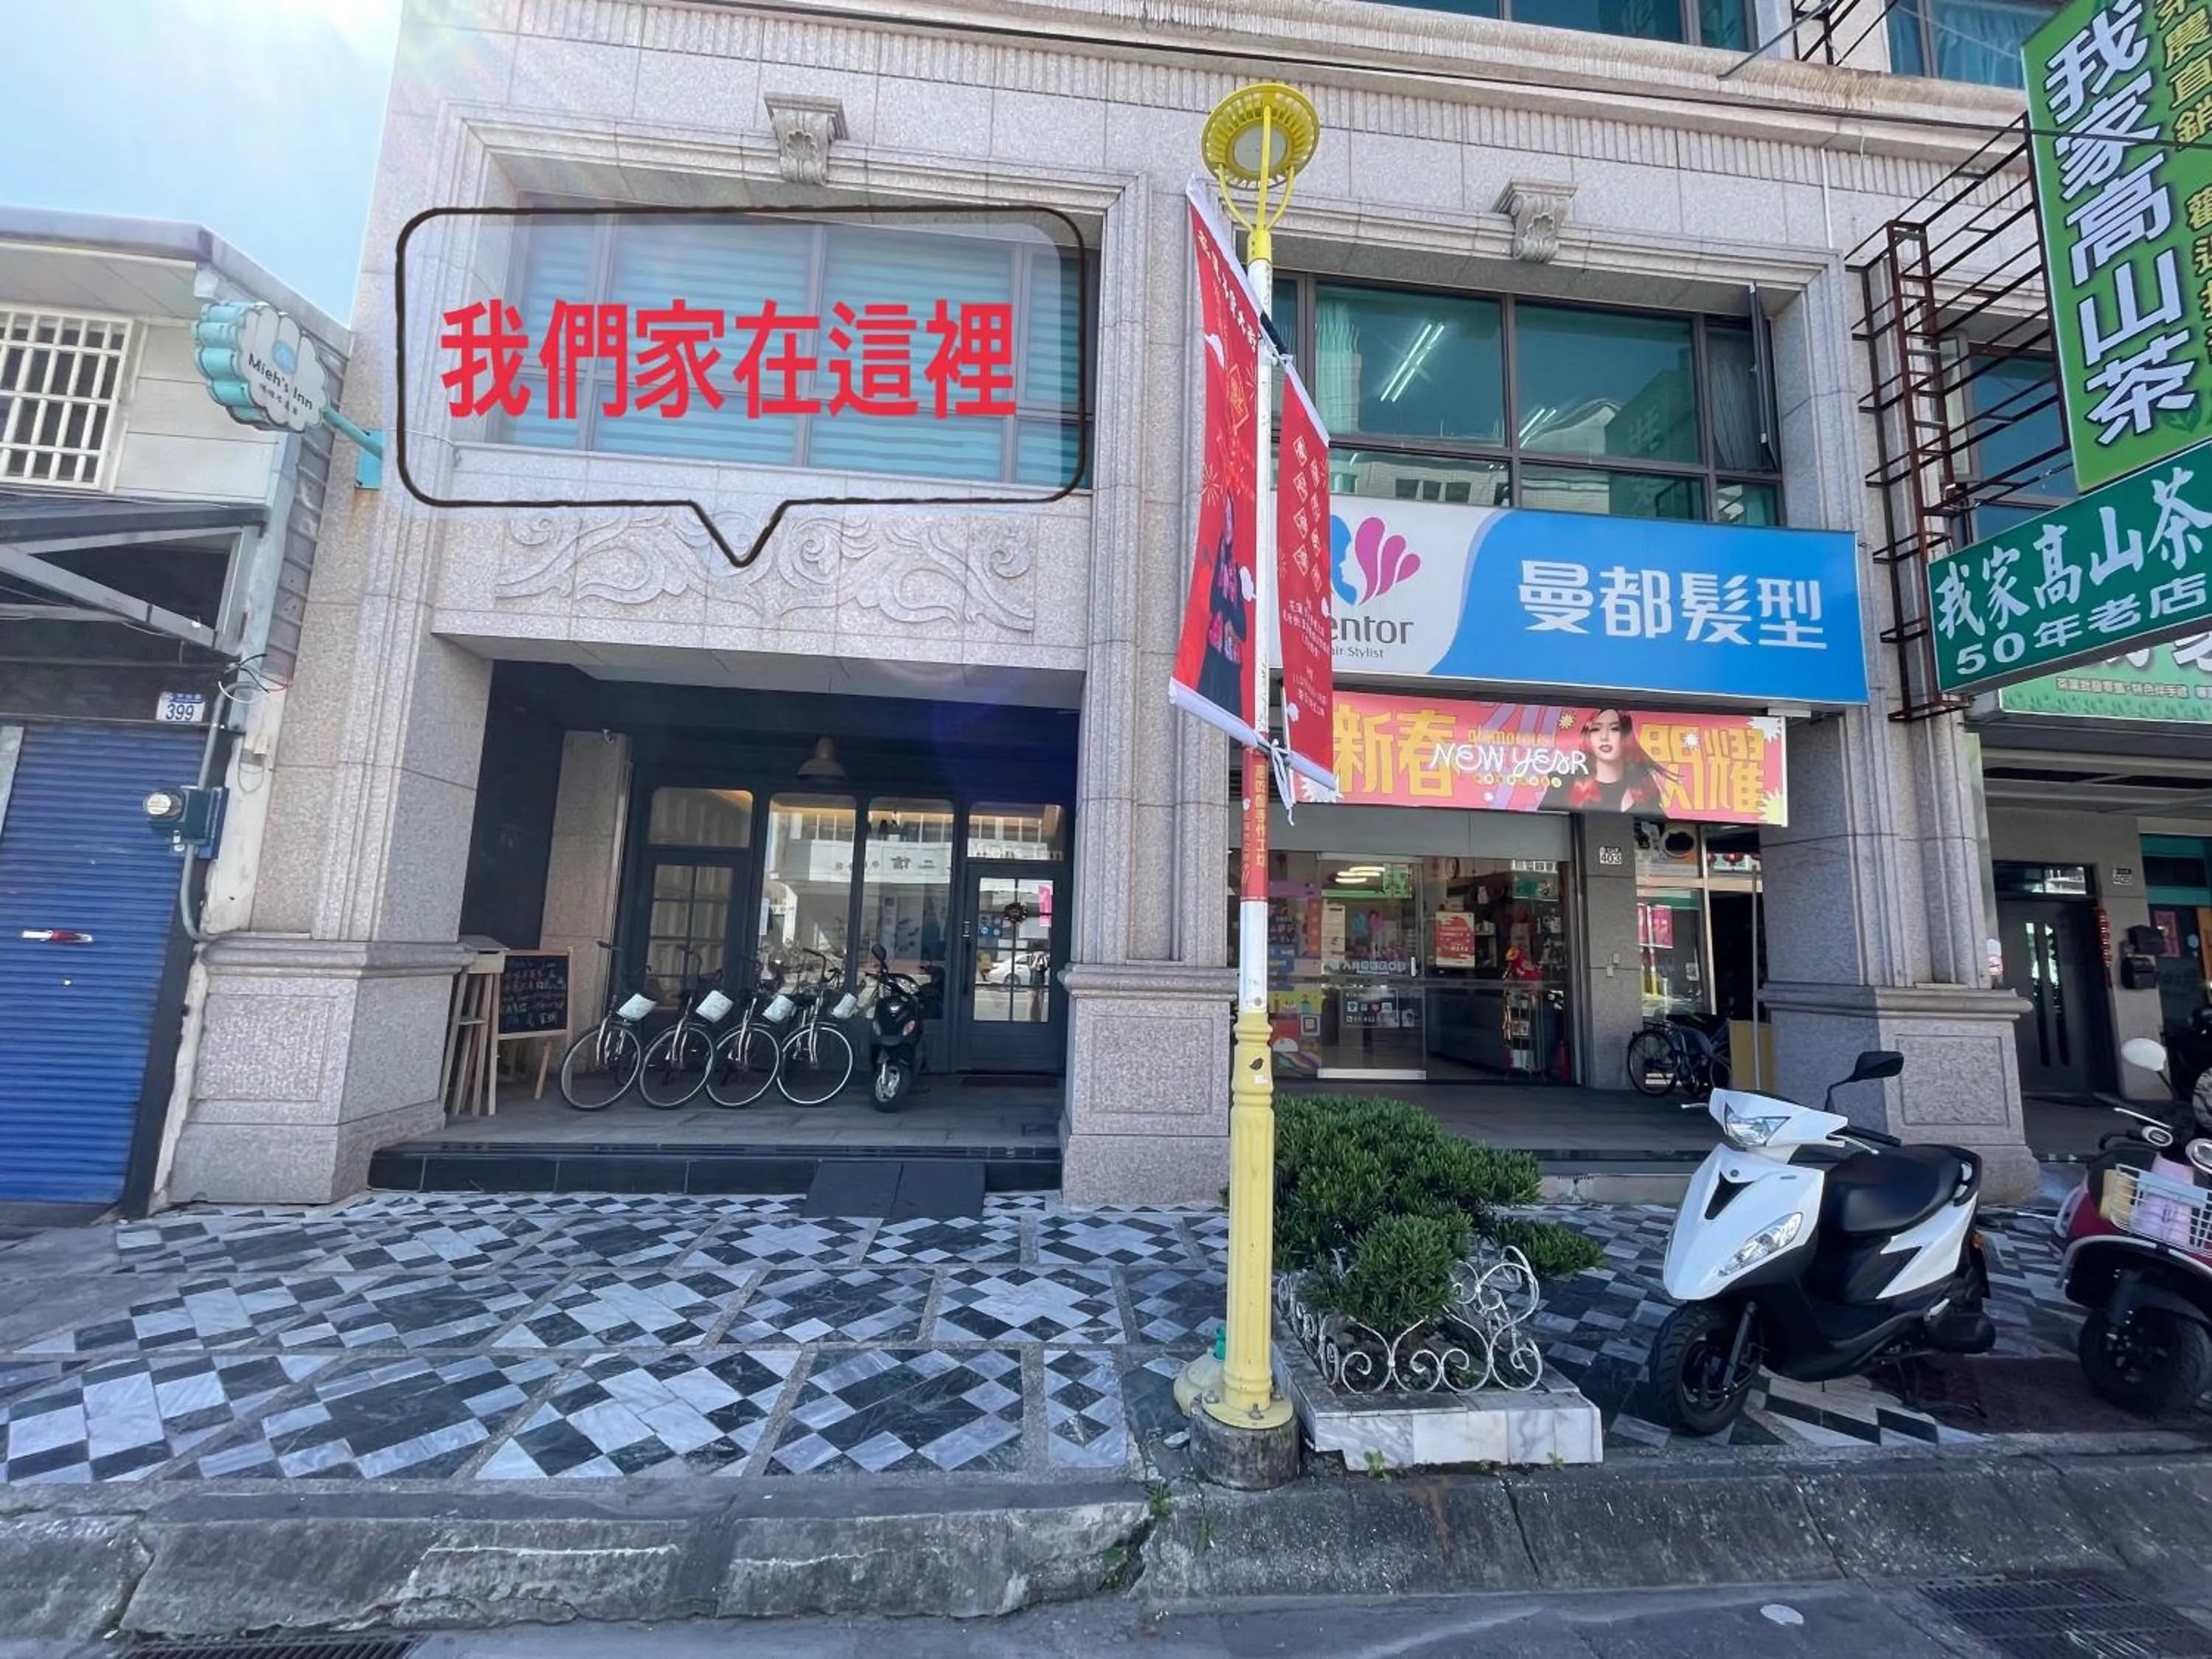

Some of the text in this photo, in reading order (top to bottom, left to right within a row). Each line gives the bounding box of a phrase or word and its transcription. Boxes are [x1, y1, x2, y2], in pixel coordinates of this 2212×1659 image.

[2045, 0, 2196, 445] 我家高山茶
[293, 386, 313, 411] Inn
[1935, 467, 2212, 640] 我家高山茶
[1518, 560, 1828, 650] 曼都髮型
[1957, 572, 2207, 675] 50年老店
[1348, 647, 1384, 659] Stylist
[166, 703, 194, 720] 399
[1332, 703, 1764, 813] 新春 閃耀
[1429, 742, 1589, 777] NEW YEAR
